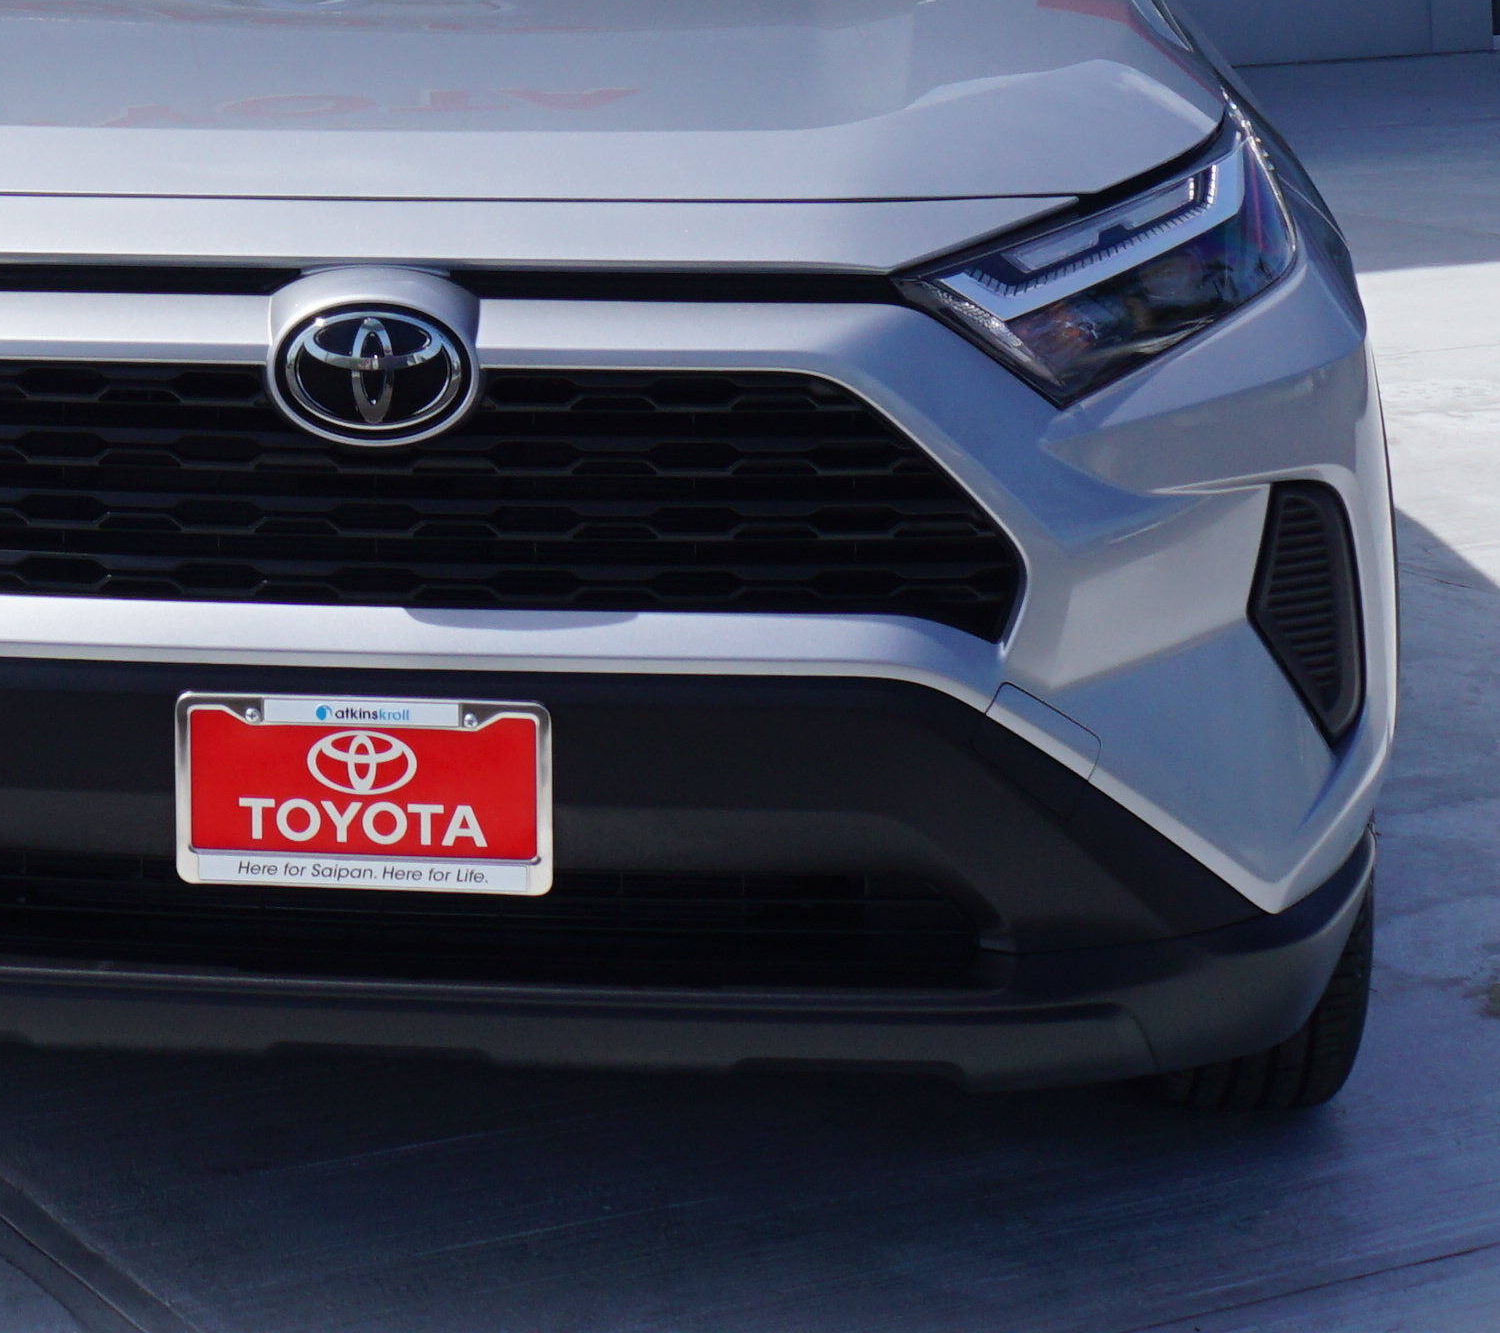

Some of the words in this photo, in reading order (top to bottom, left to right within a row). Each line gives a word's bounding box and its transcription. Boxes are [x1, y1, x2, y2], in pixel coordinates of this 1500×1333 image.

[334, 707, 410, 721] atkinskroll
[238, 796, 488, 848] TOYOTA
[237, 860, 278, 876] Here
[283, 862, 307, 877] for
[311, 863, 378, 881] Saipan.
[382, 866, 423, 881] Here
[428, 868, 451, 882] for
[456, 868, 489, 884] Life.
